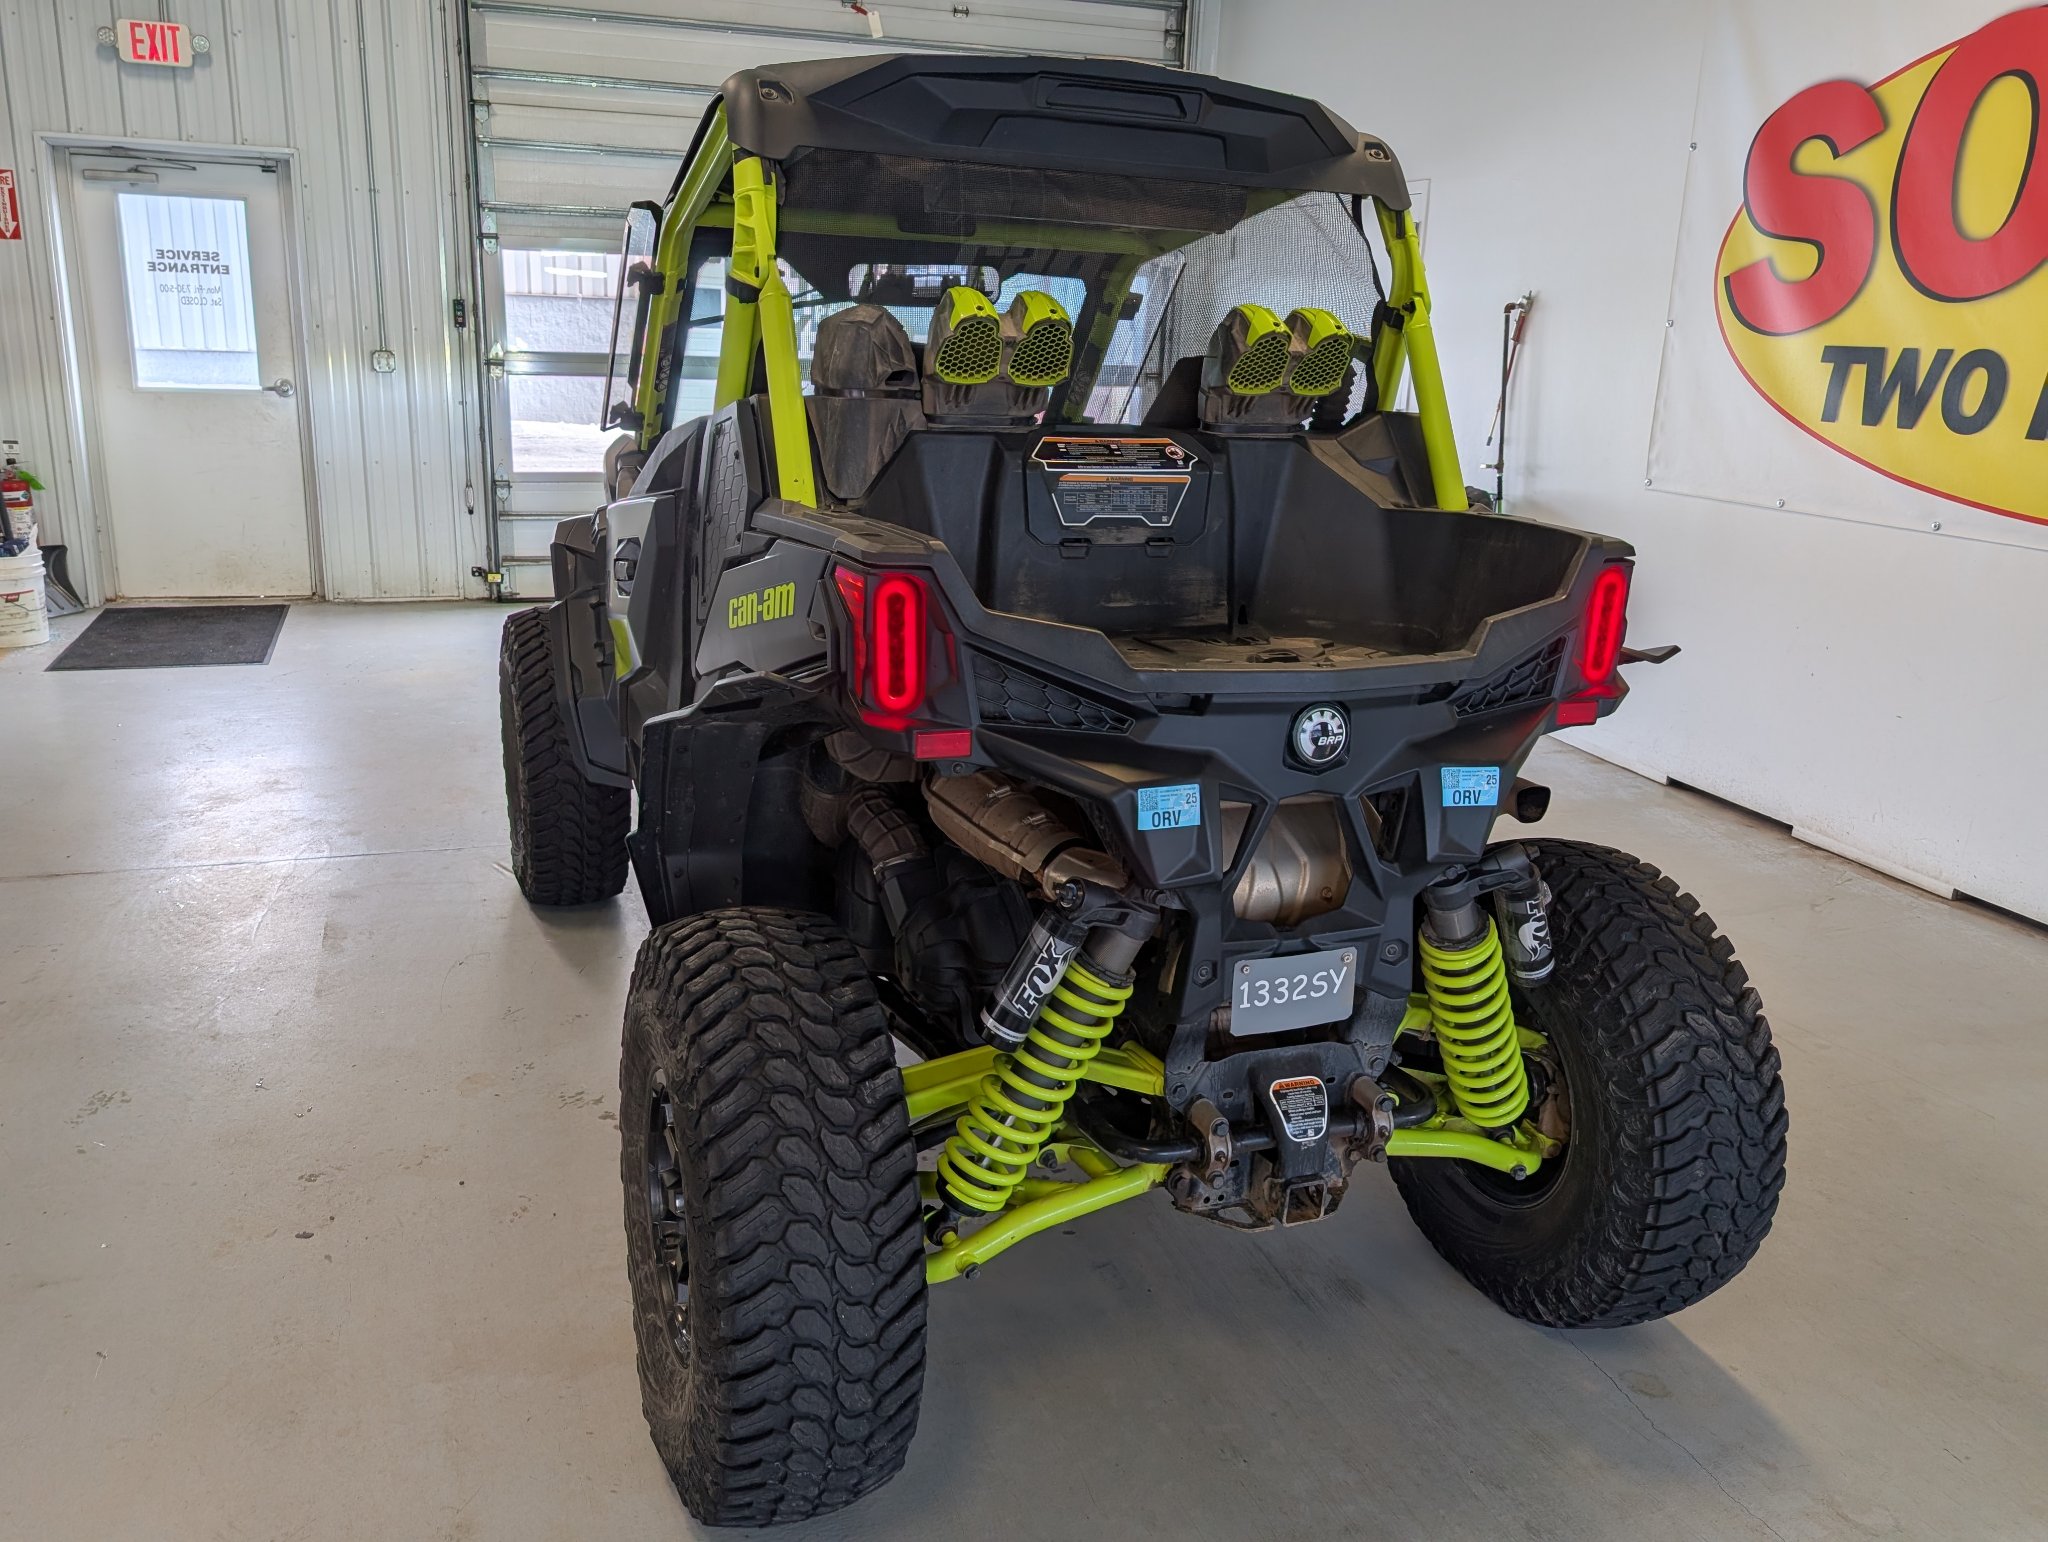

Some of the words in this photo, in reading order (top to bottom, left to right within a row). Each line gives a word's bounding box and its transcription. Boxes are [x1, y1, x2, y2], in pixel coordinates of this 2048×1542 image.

[130, 21, 180, 64] EXIT
[1820, 345, 2008, 435] TWO
[728, 581, 796, 629] can-am
[1317, 735, 1343, 746] BRP
[1485, 774, 1498, 785] 25
[1185, 792, 1198, 805] 25
[1452, 789, 1481, 805] ORV
[1151, 810, 1182, 828] ORV
[1520, 900, 1552, 952] FOX
[1012, 936, 1067, 1019] FOX
[1239, 966, 1348, 1009] 1332SY
[1285, 1080, 1315, 1088] WARNING
